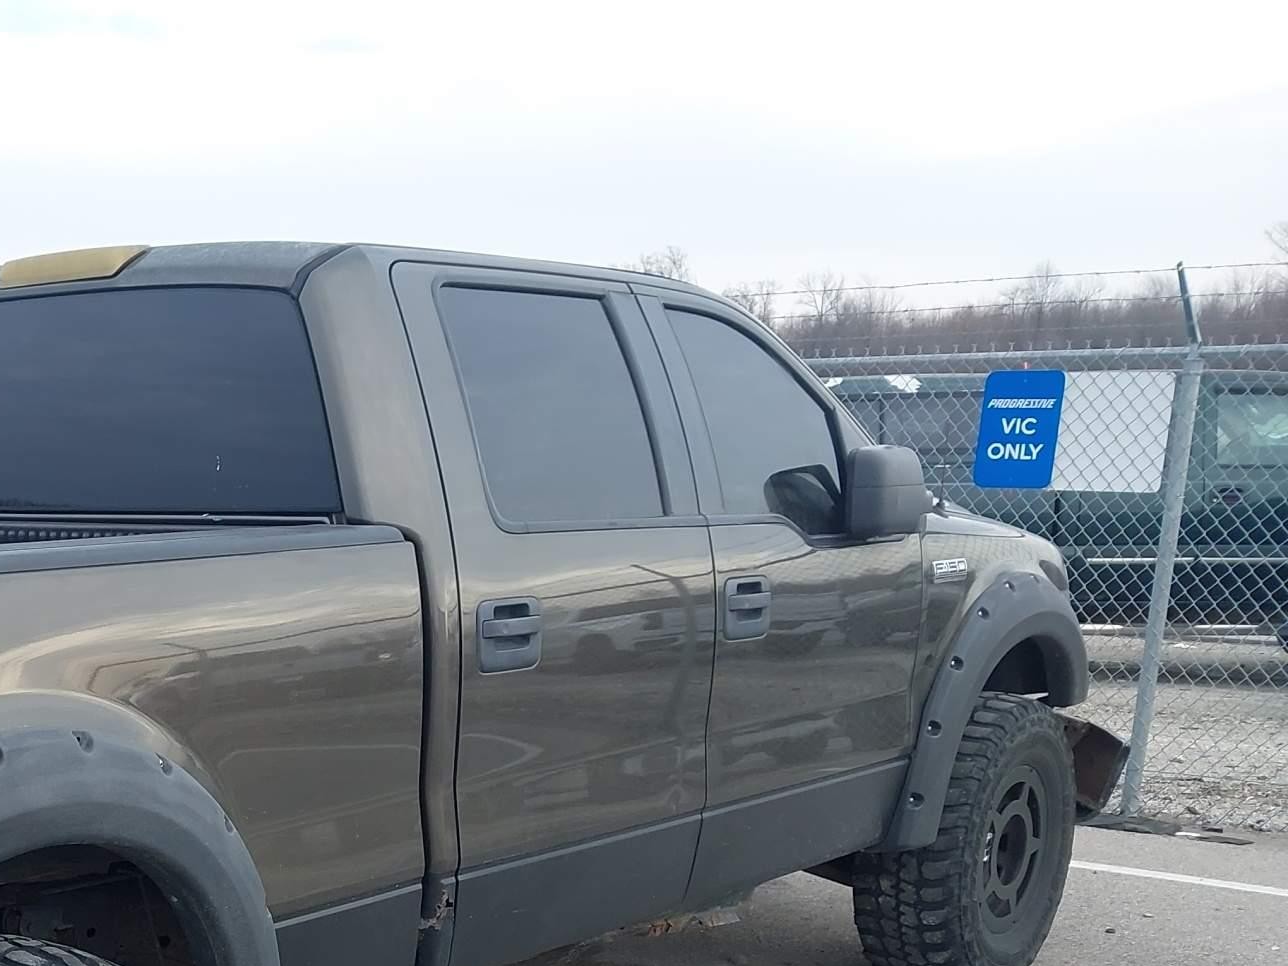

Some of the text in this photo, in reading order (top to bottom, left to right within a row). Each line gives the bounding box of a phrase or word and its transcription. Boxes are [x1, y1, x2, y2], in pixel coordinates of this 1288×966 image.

[987, 398, 1056, 409] PROGRESSIVE
[1001, 417, 1038, 435] VIC
[986, 442, 1045, 460] ONLY
